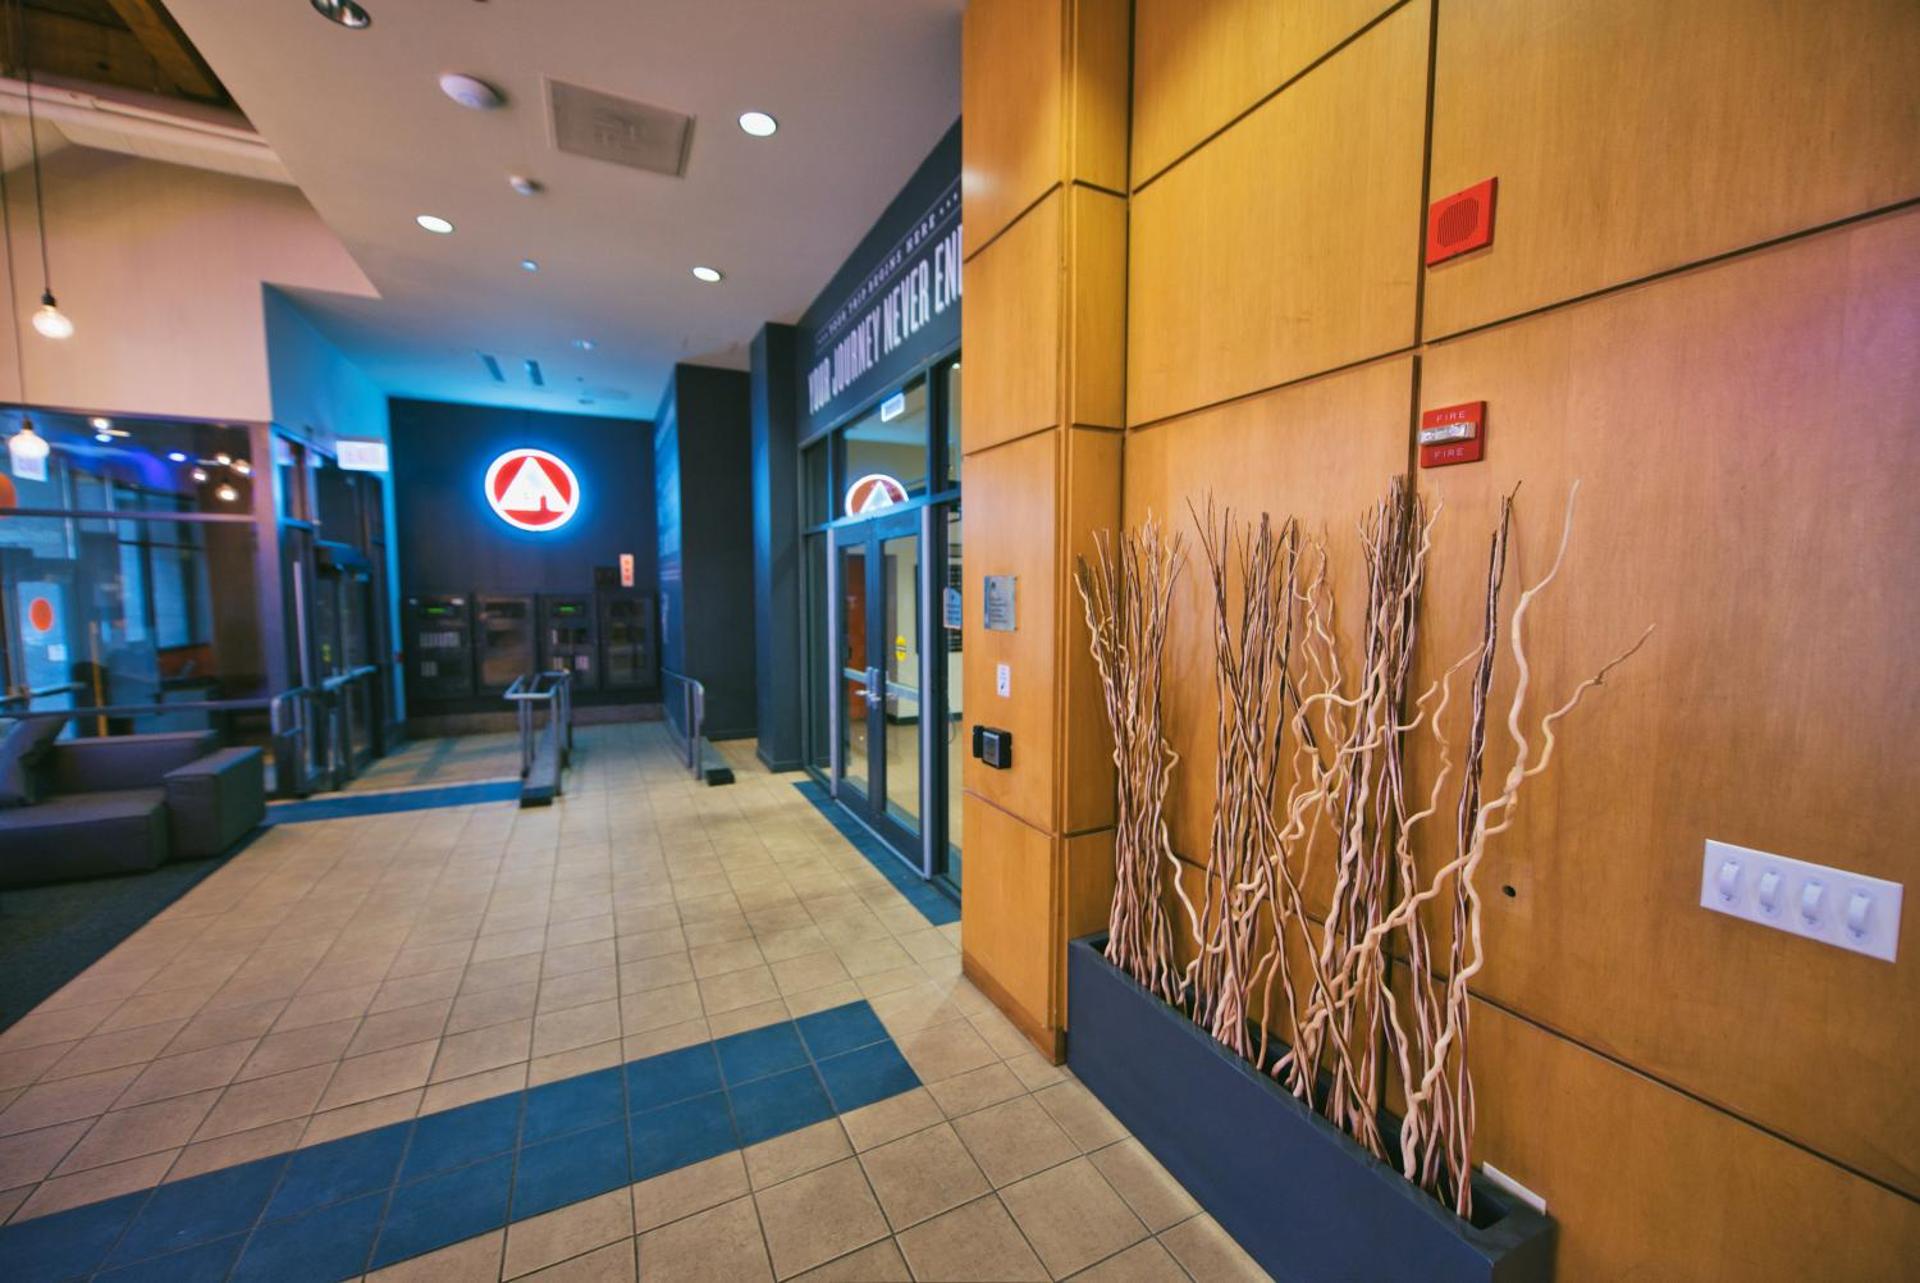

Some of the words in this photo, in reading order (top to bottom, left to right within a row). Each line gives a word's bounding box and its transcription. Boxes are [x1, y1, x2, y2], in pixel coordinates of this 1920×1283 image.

[848, 288, 866, 314] TRIP
[868, 249, 902, 292] BEGINS
[905, 213, 936, 253] HERE
[808, 356, 832, 416] YOUR
[832, 305, 881, 397] JOURNEY
[883, 258, 930, 355] NEVER
[1436, 410, 1466, 422] FIRE
[1433, 447, 1465, 459] FIRE
